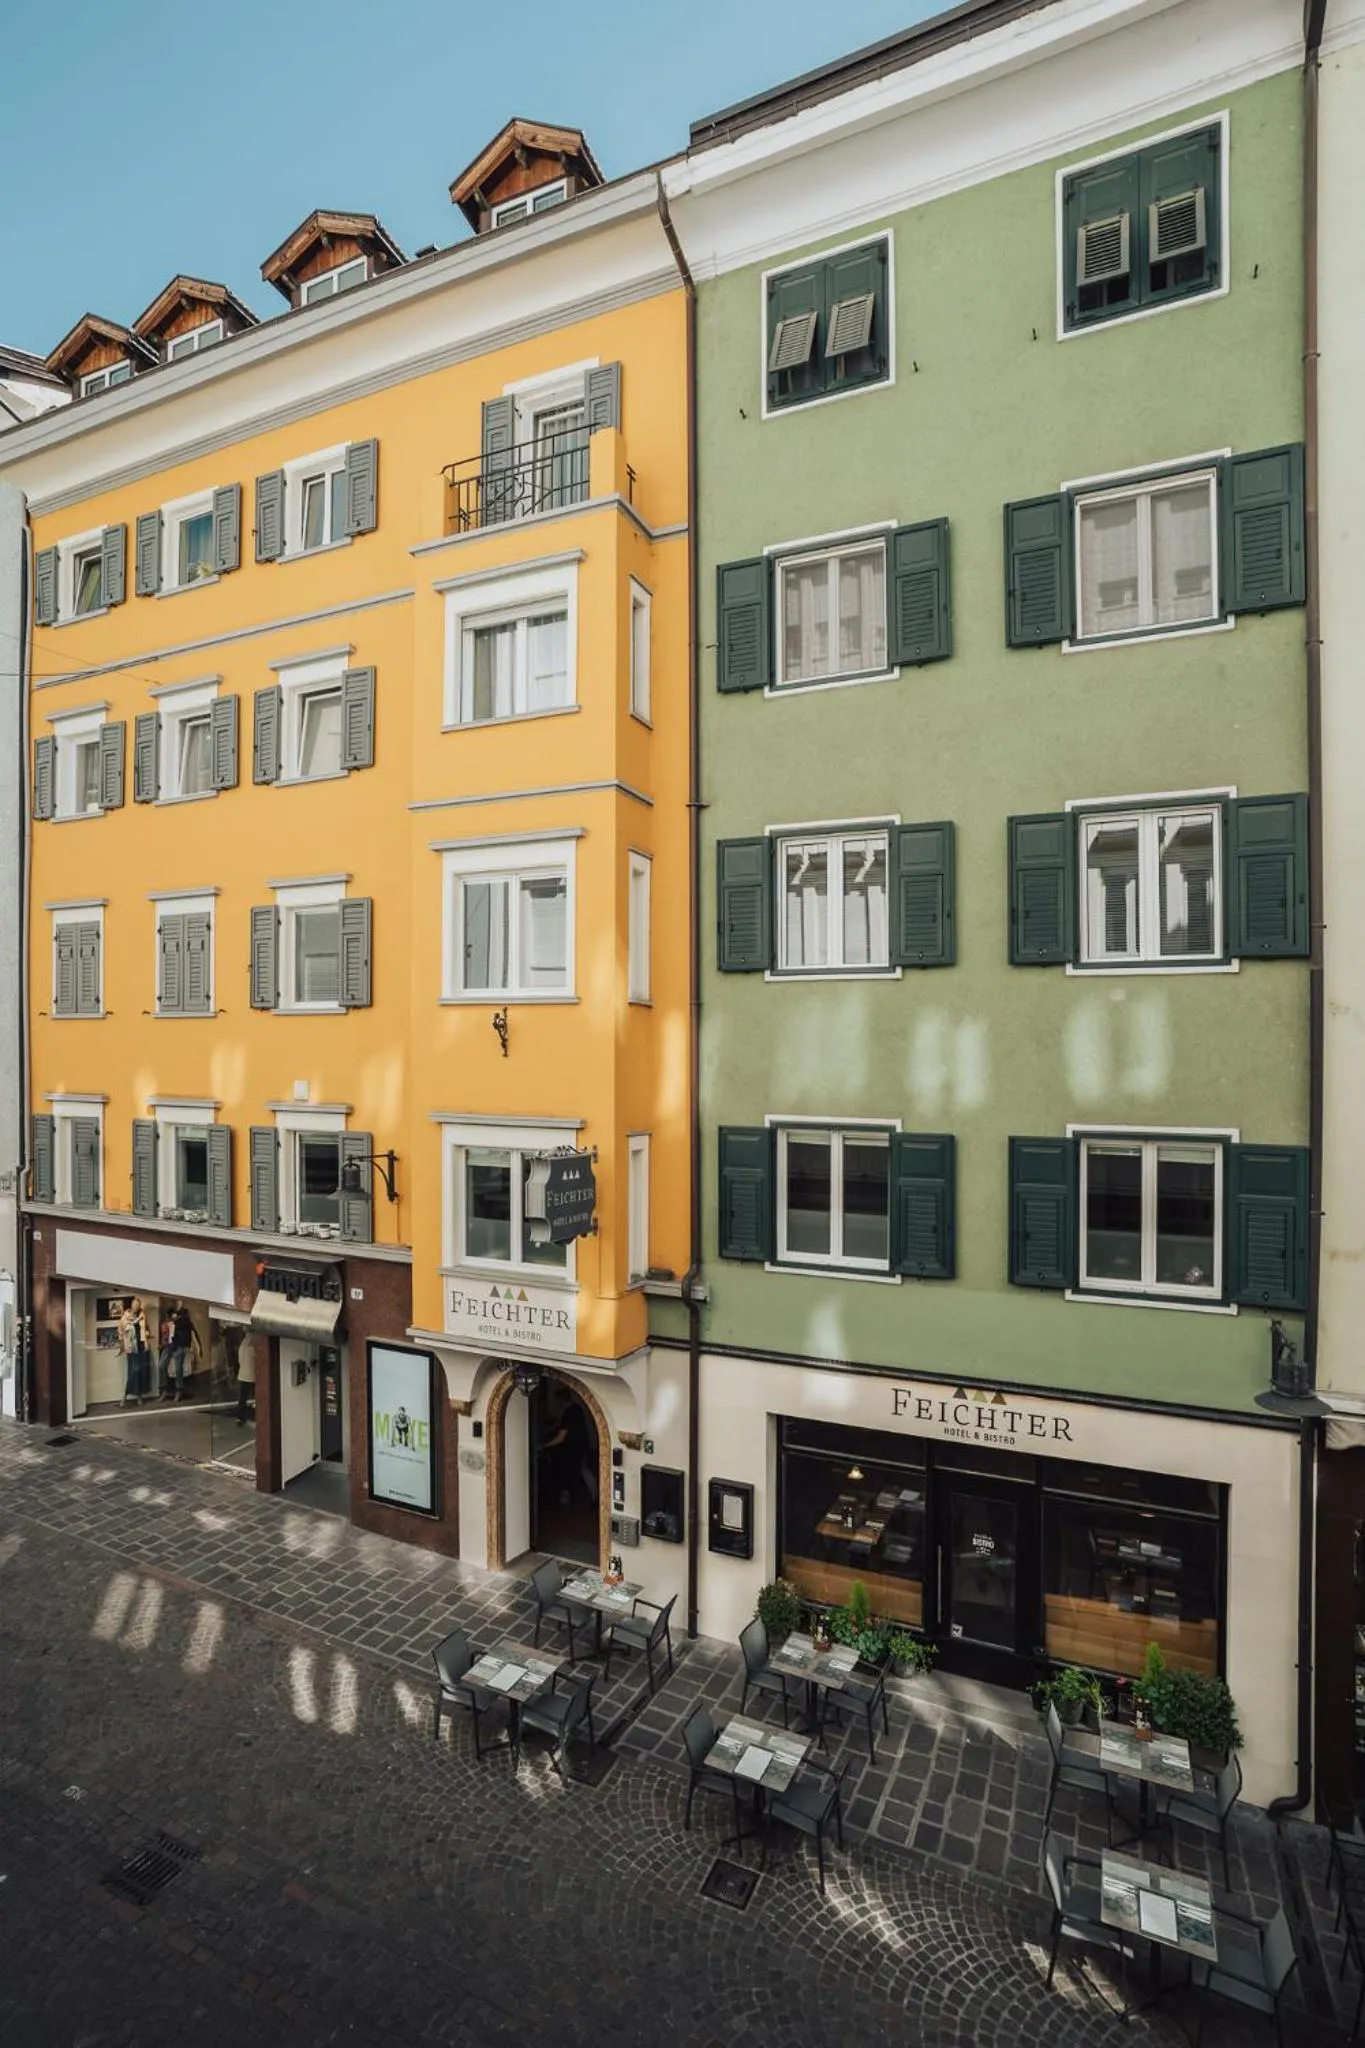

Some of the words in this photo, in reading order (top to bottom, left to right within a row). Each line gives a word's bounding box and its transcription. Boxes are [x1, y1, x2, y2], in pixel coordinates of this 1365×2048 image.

[547, 1188, 594, 1207] FEICHTER
[450, 1290, 571, 1330] FEICHTER
[478, 1324, 502, 1336] HOTEL
[504, 1328, 510, 1337] &
[513, 1329, 541, 1341] BISTRO
[890, 1387, 1074, 1442] FEICHTER
[943, 1426, 971, 1439] HOTEL
[973, 1431, 980, 1440] &
[984, 1433, 1015, 1446] BISTRO
